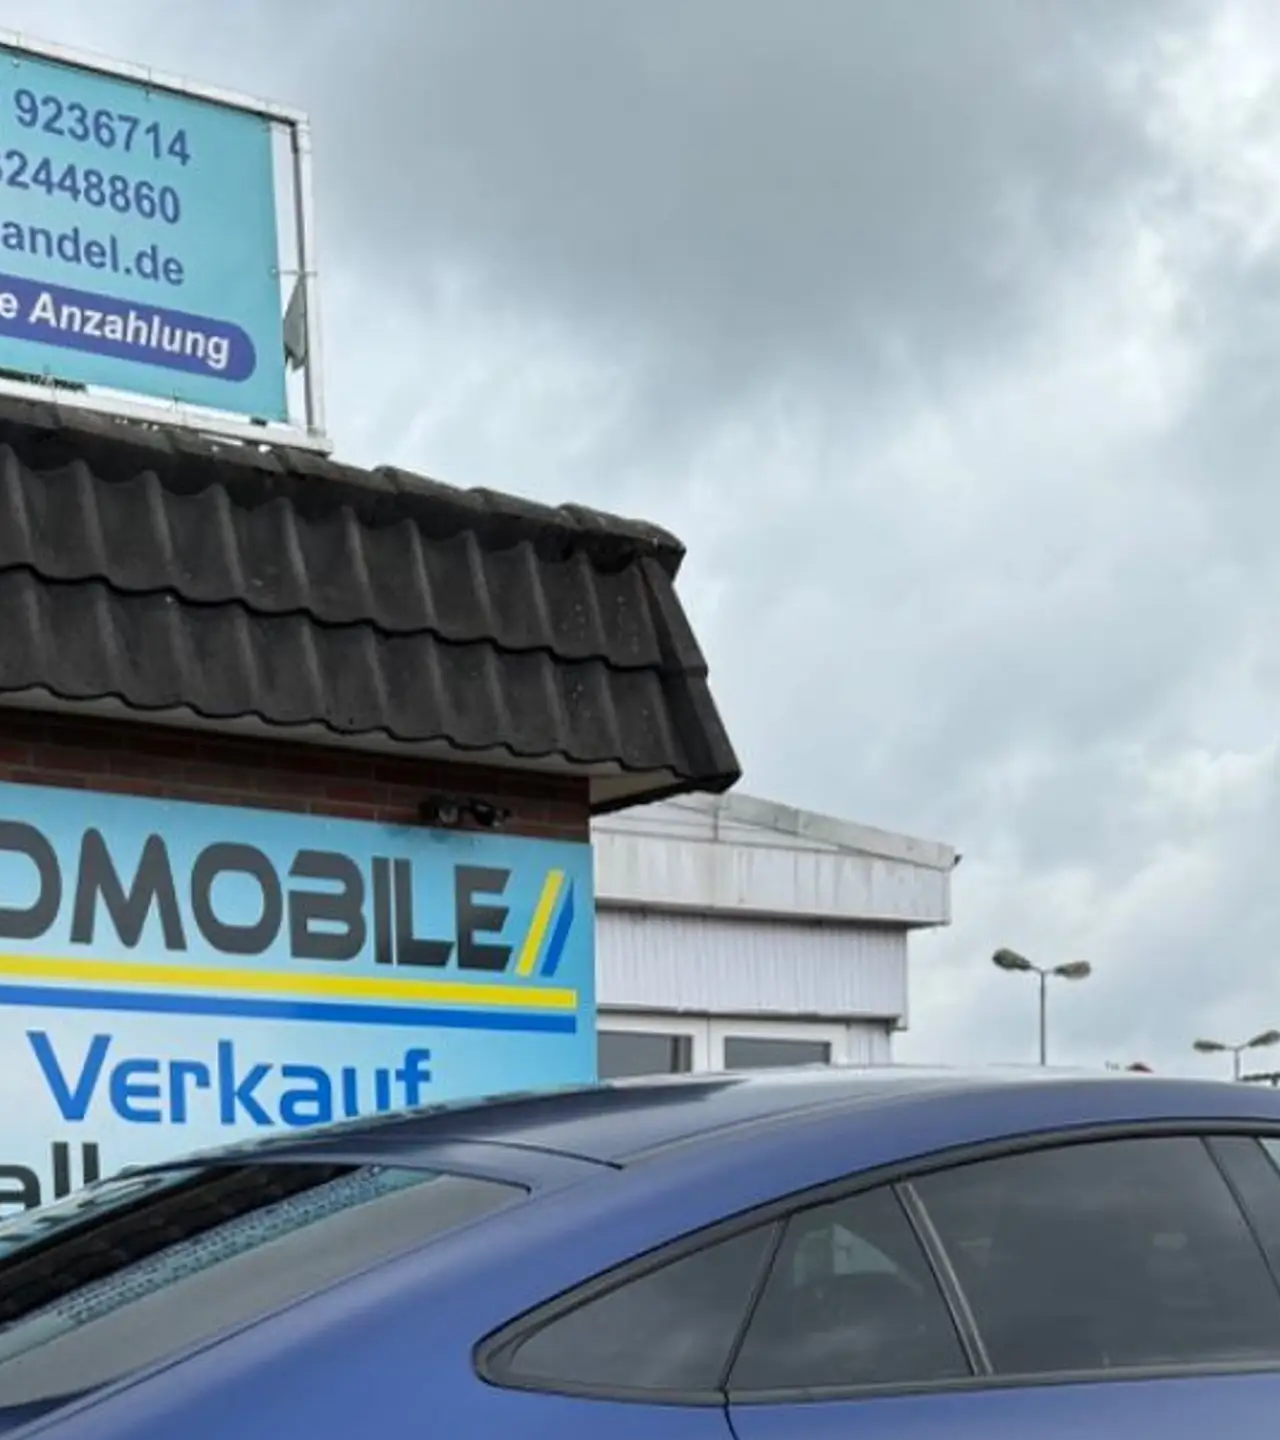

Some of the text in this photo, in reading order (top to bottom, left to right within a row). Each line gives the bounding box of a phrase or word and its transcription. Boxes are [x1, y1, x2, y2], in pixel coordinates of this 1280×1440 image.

[15, 89, 191, 165] 9236714
[28, 292, 231, 368] Anzahlung
[26, 1029, 432, 1126] Verkauf
